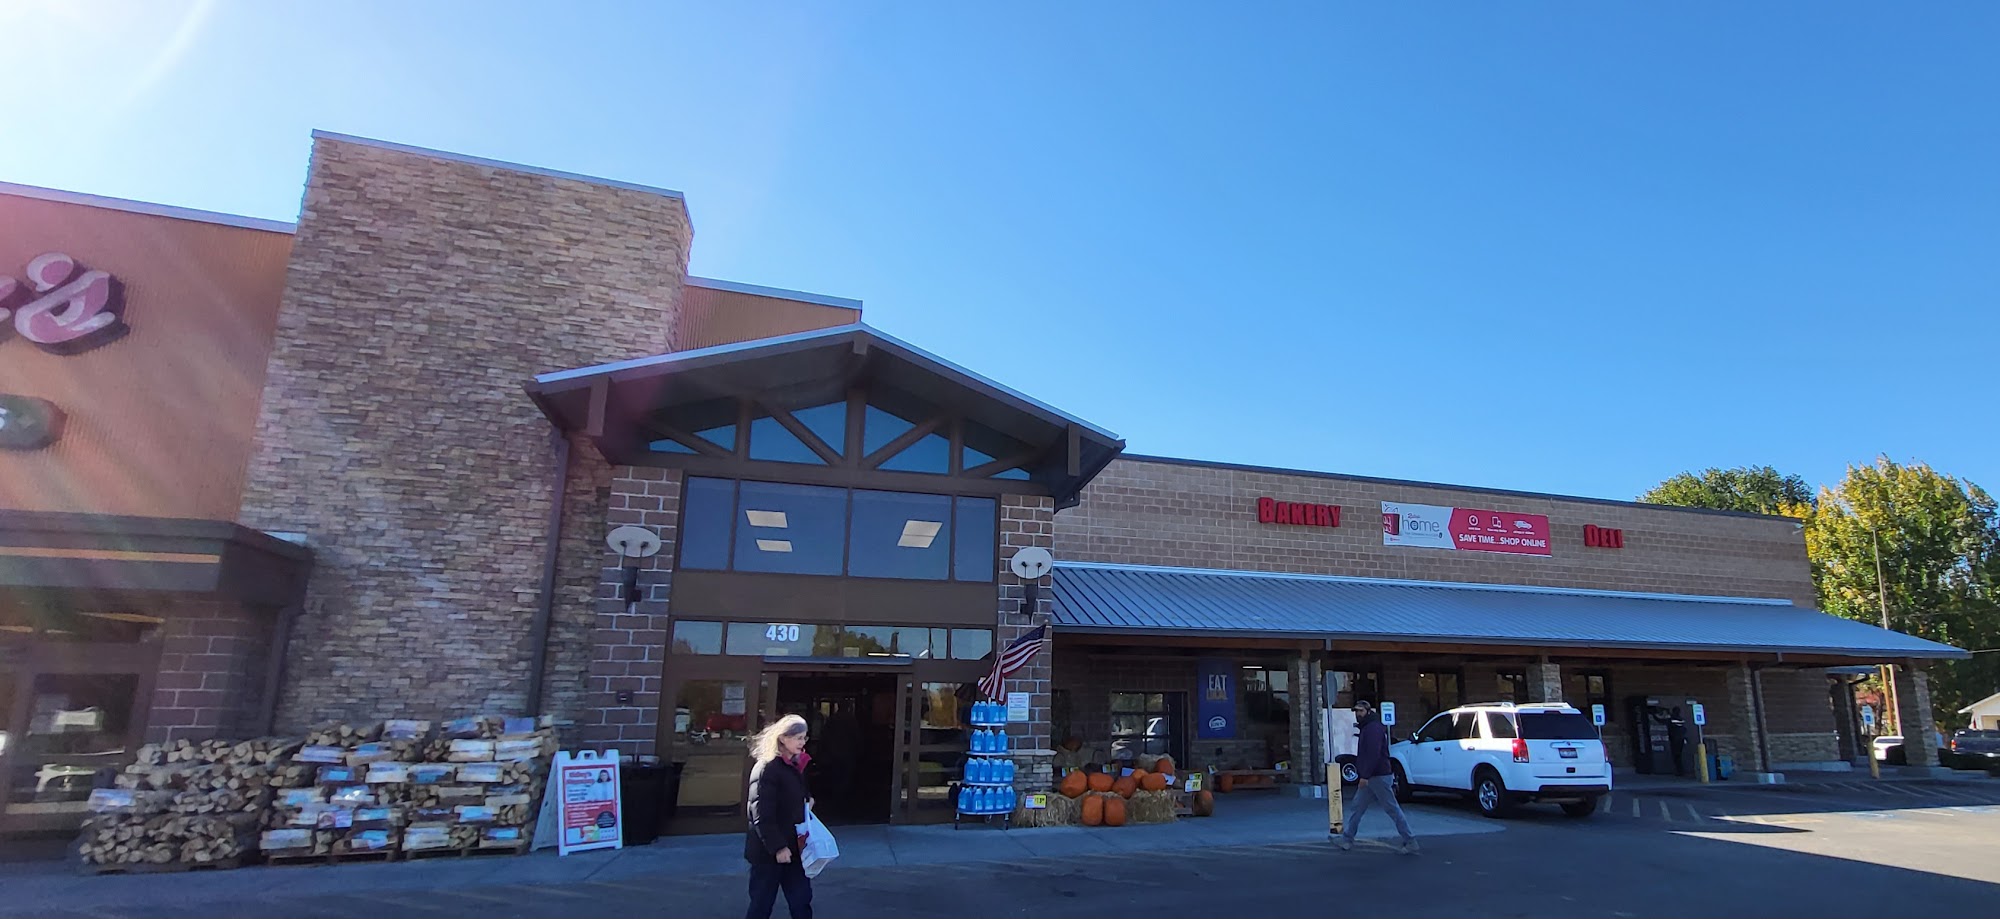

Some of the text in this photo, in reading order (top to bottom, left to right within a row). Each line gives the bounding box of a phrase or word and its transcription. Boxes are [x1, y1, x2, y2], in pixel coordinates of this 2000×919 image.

[1259, 497, 1341, 527] BAKERY
[1402, 514, 1440, 532] home
[1459, 533, 1477, 543] SAVE
[1521, 538, 1546, 548] ONLINE
[1583, 524, 1623, 548] DELI
[766, 624, 800, 642] 430
[1208, 674, 1228, 691] EAT
